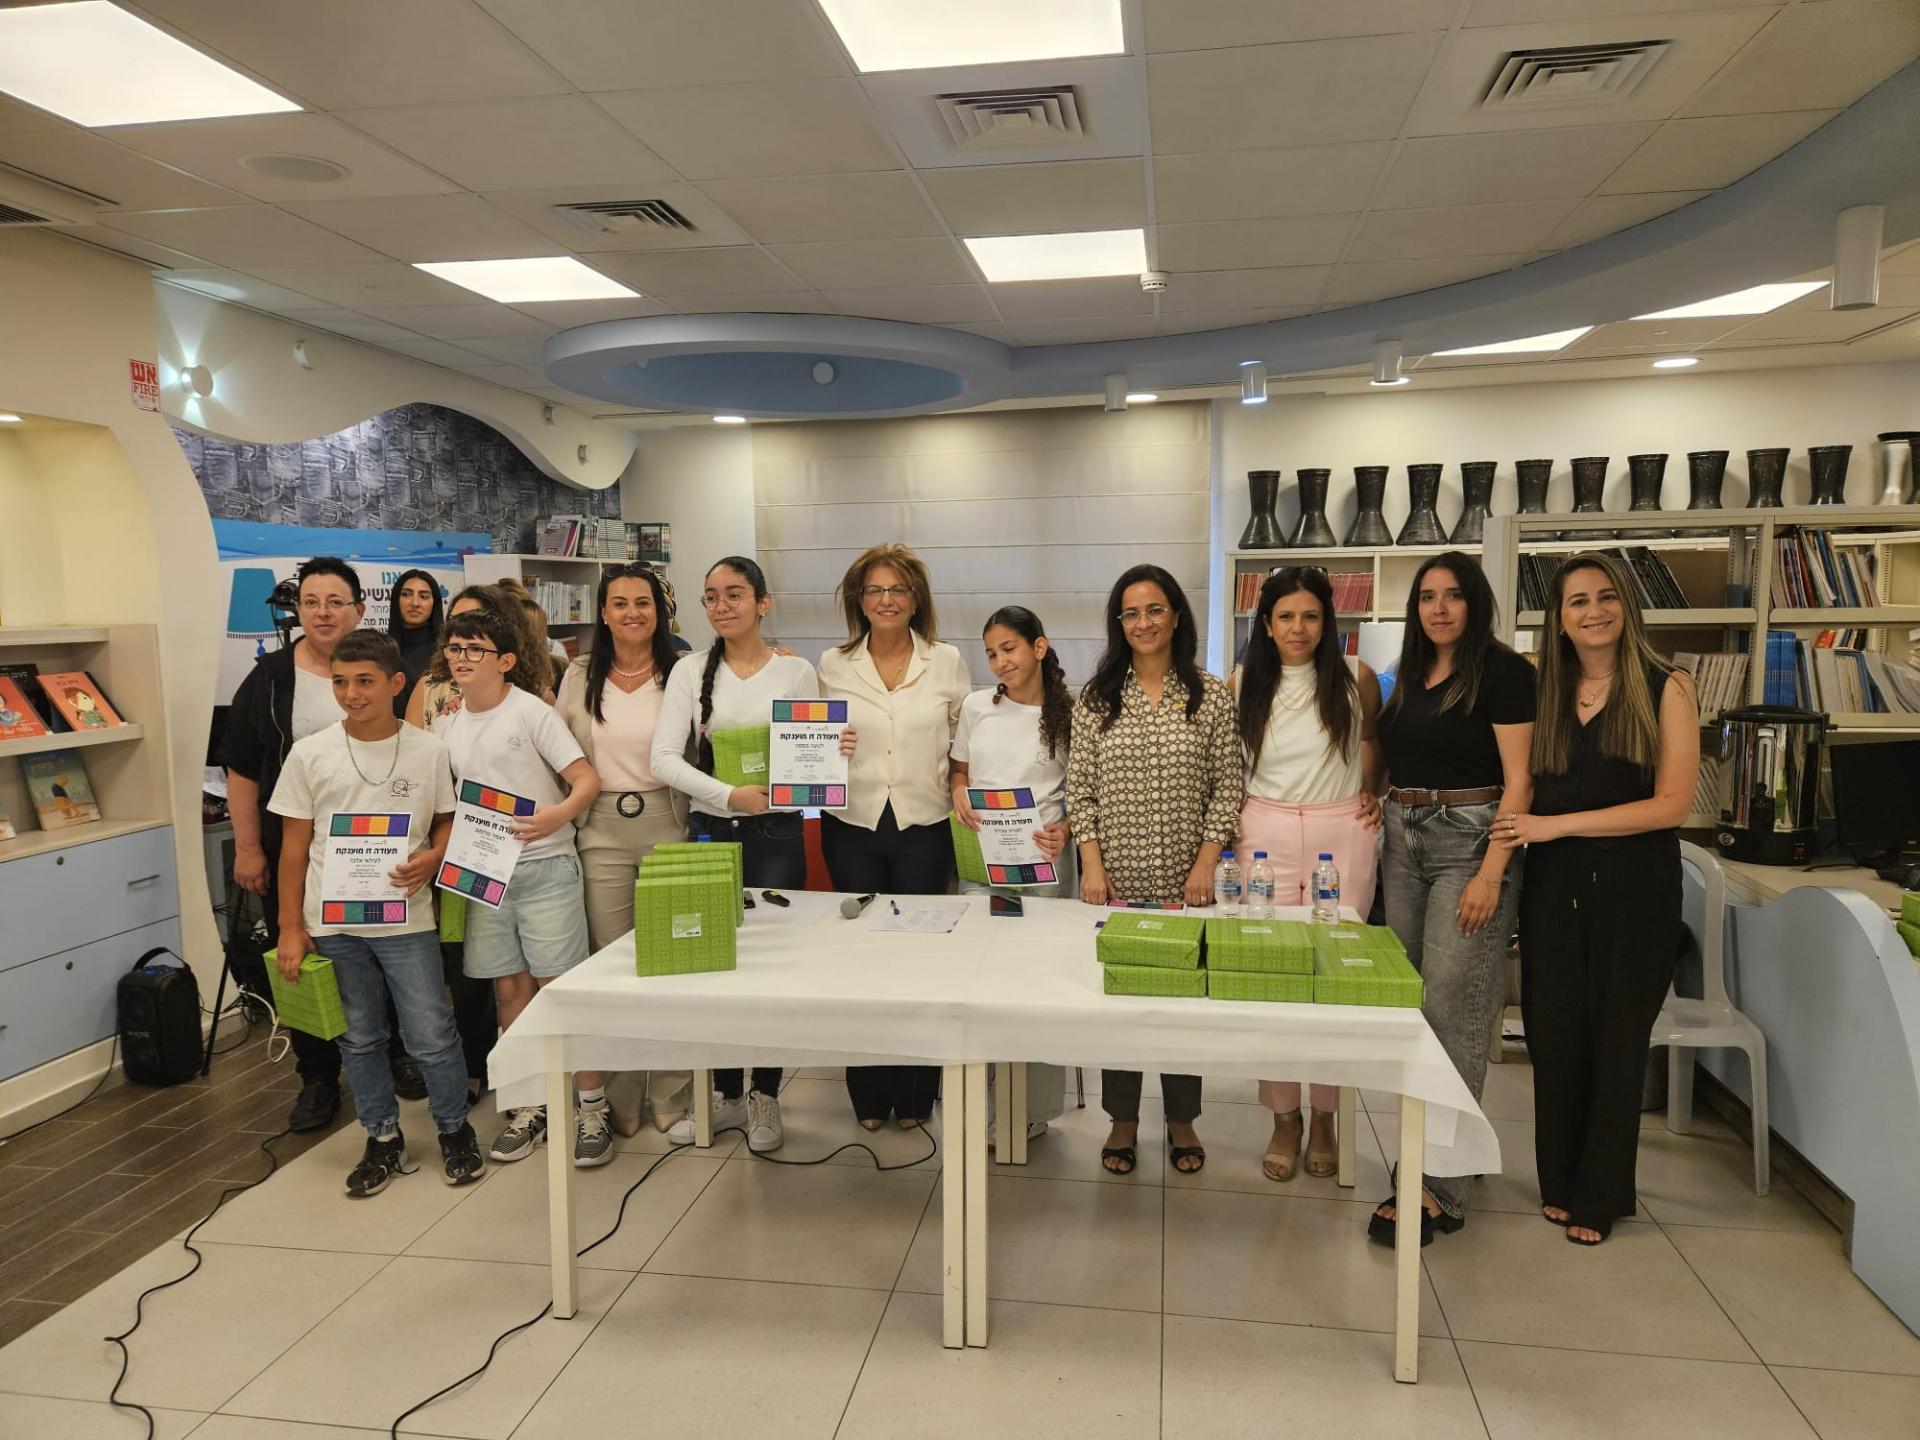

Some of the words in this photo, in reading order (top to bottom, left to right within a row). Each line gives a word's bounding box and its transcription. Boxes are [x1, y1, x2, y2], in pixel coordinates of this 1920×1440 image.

[130, 362, 157, 385] אש
[133, 382, 159, 397] FIRE
[360, 588, 393, 602] גשים
[780, 733, 807, 741] מוענקת
[816, 733, 839, 741] תעודה
[464, 813, 491, 828] מוענקת
[335, 847, 364, 856] מוענקת
[373, 847, 398, 856] תעודה
